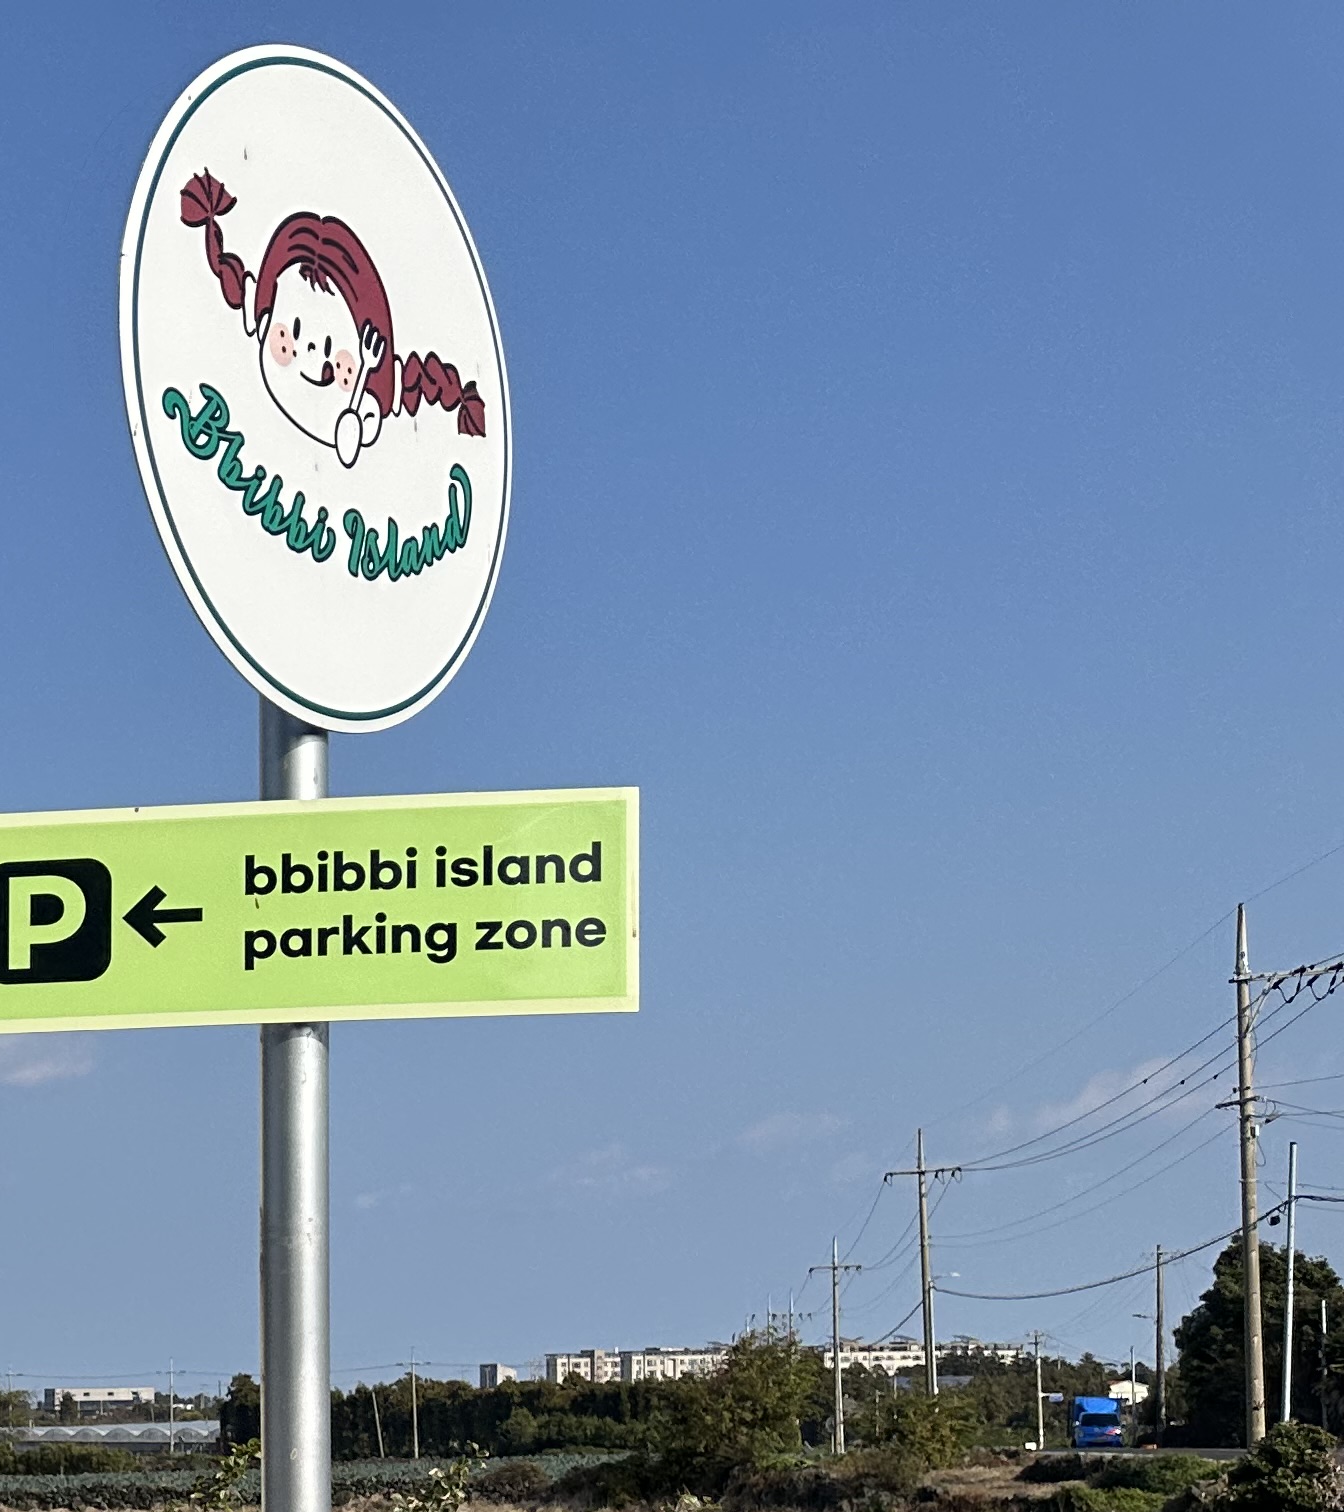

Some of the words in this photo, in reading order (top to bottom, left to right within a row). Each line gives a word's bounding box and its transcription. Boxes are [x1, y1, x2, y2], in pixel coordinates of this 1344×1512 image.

[161, 382, 336, 563] Bbibbi
[343, 463, 473, 582] Island
[243, 845, 419, 897] bbibbi
[434, 840, 603, 889] island
[7, 874, 88, 971] P
[243, 911, 459, 971] parking
[474, 916, 608, 952] zone
